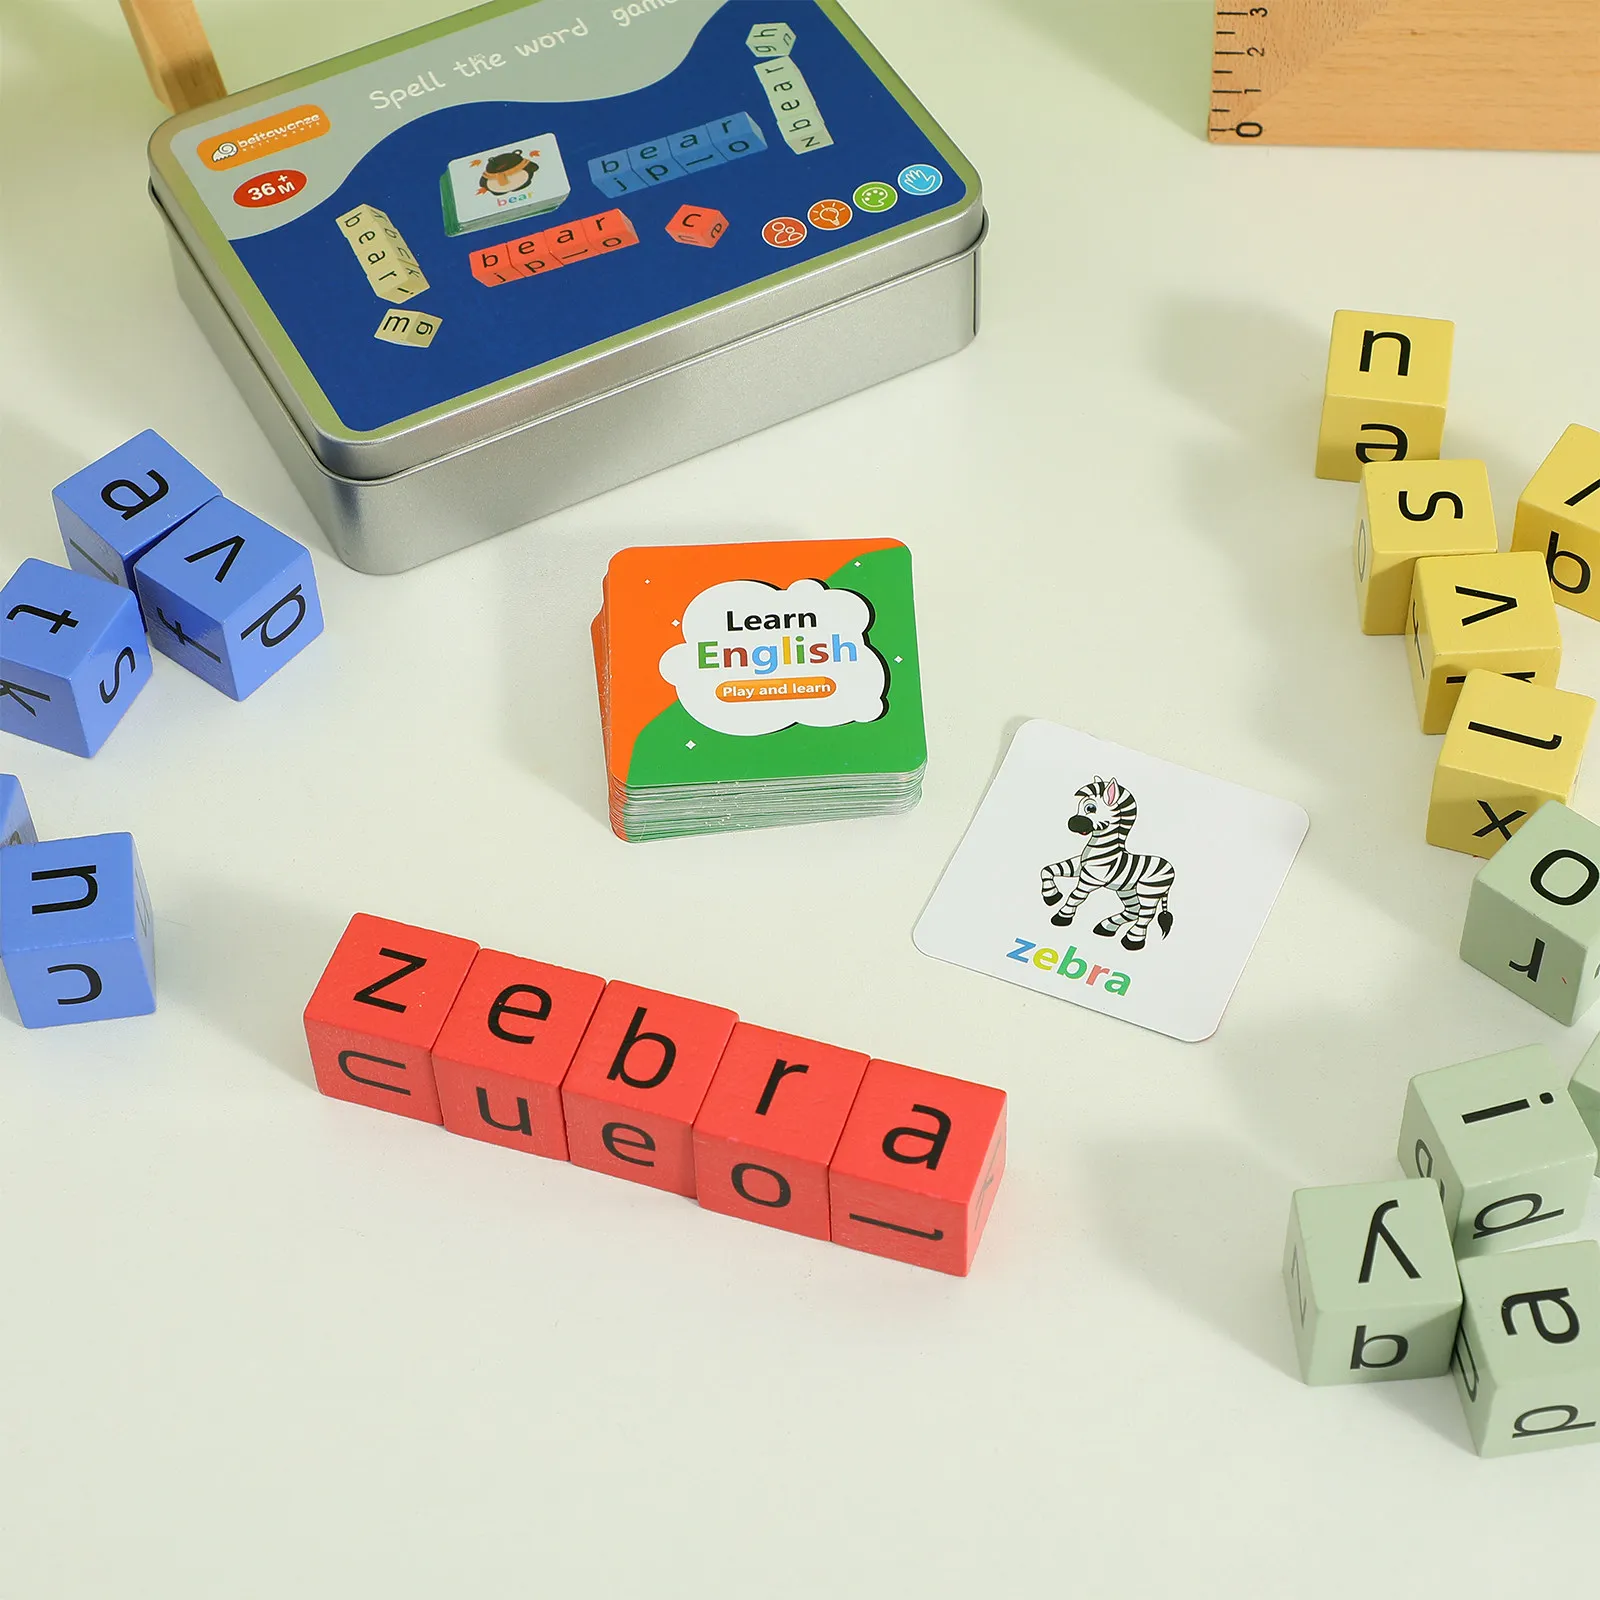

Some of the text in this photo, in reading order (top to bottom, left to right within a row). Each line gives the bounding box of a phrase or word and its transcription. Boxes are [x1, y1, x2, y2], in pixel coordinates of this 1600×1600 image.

[1250, 7, 1268, 18] 3
[369, 71, 446, 110] Spell
[453, 52, 506, 78] the
[514, 17, 589, 57] word
[1246, 46, 1265, 58] 2
[1235, 121, 1263, 138] 0
[247, 182, 276, 201] 36
[497, 192, 533, 207] bear
[100, 469, 170, 521] a
[1397, 490, 1464, 521] s
[726, 609, 818, 632] Learn
[697, 633, 858, 674] English
[99, 646, 136, 704] s
[722, 682, 831, 699] Play and learn
[1530, 849, 1600, 906] o
[1005, 937, 1132, 997] zebra
[601, 1121, 657, 1168] e
[731, 1162, 792, 1209] o
[1501, 1287, 1580, 1345] a
